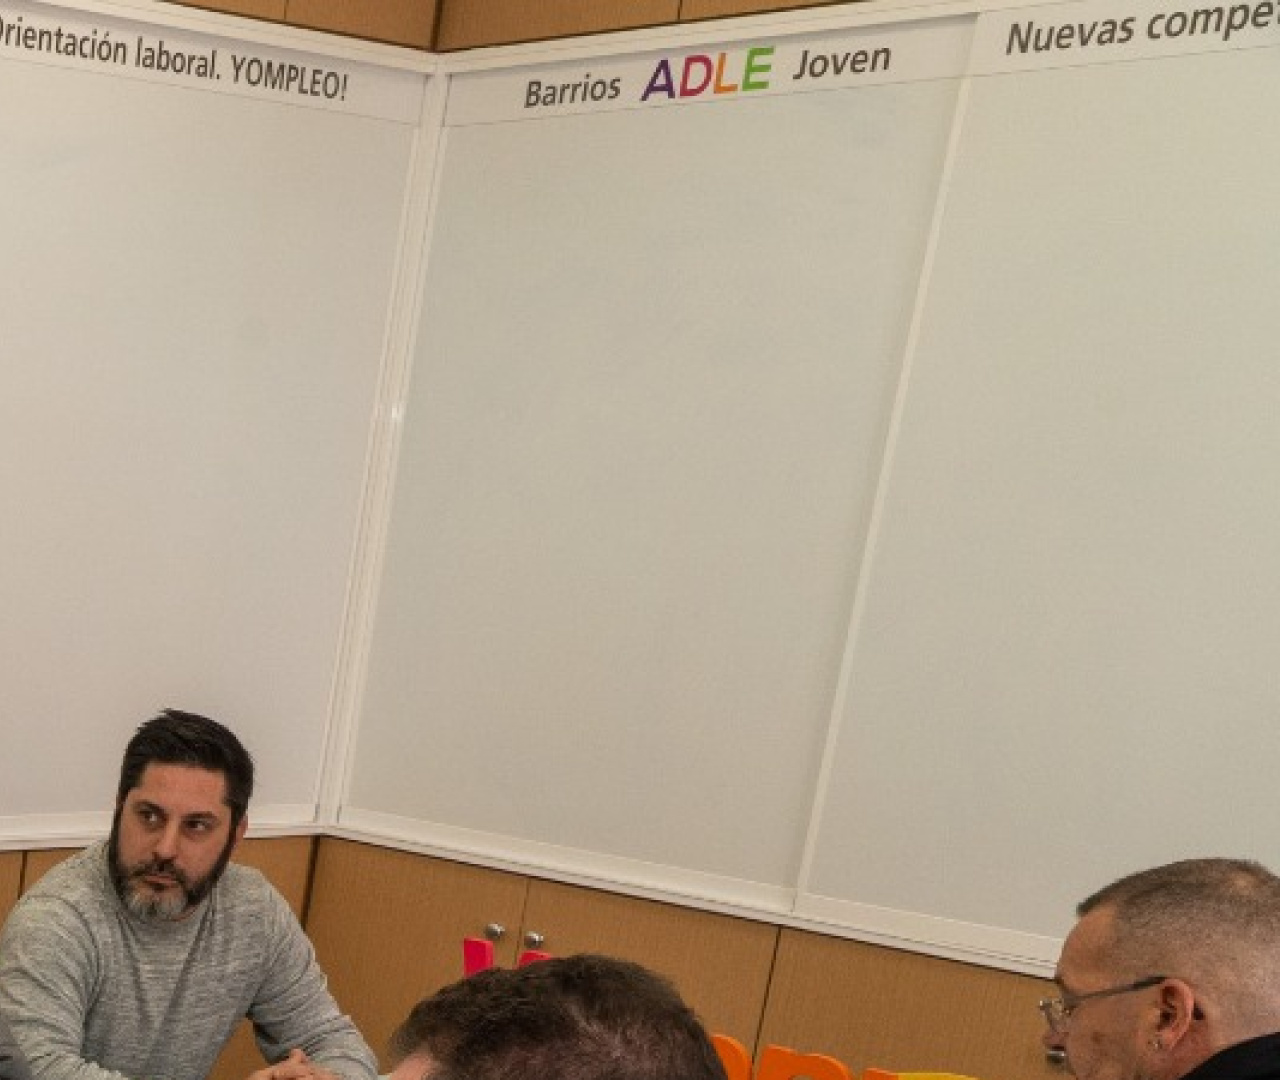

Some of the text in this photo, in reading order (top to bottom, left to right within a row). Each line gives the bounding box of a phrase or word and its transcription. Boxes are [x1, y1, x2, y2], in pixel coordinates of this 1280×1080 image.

[1005, 16, 1137, 55] Nuevas
[134, 36, 221, 80] laboral.
[230, 54, 349, 101] YOMPLEO!
[523, 46, 892, 108] Barrios ADLE Joven
